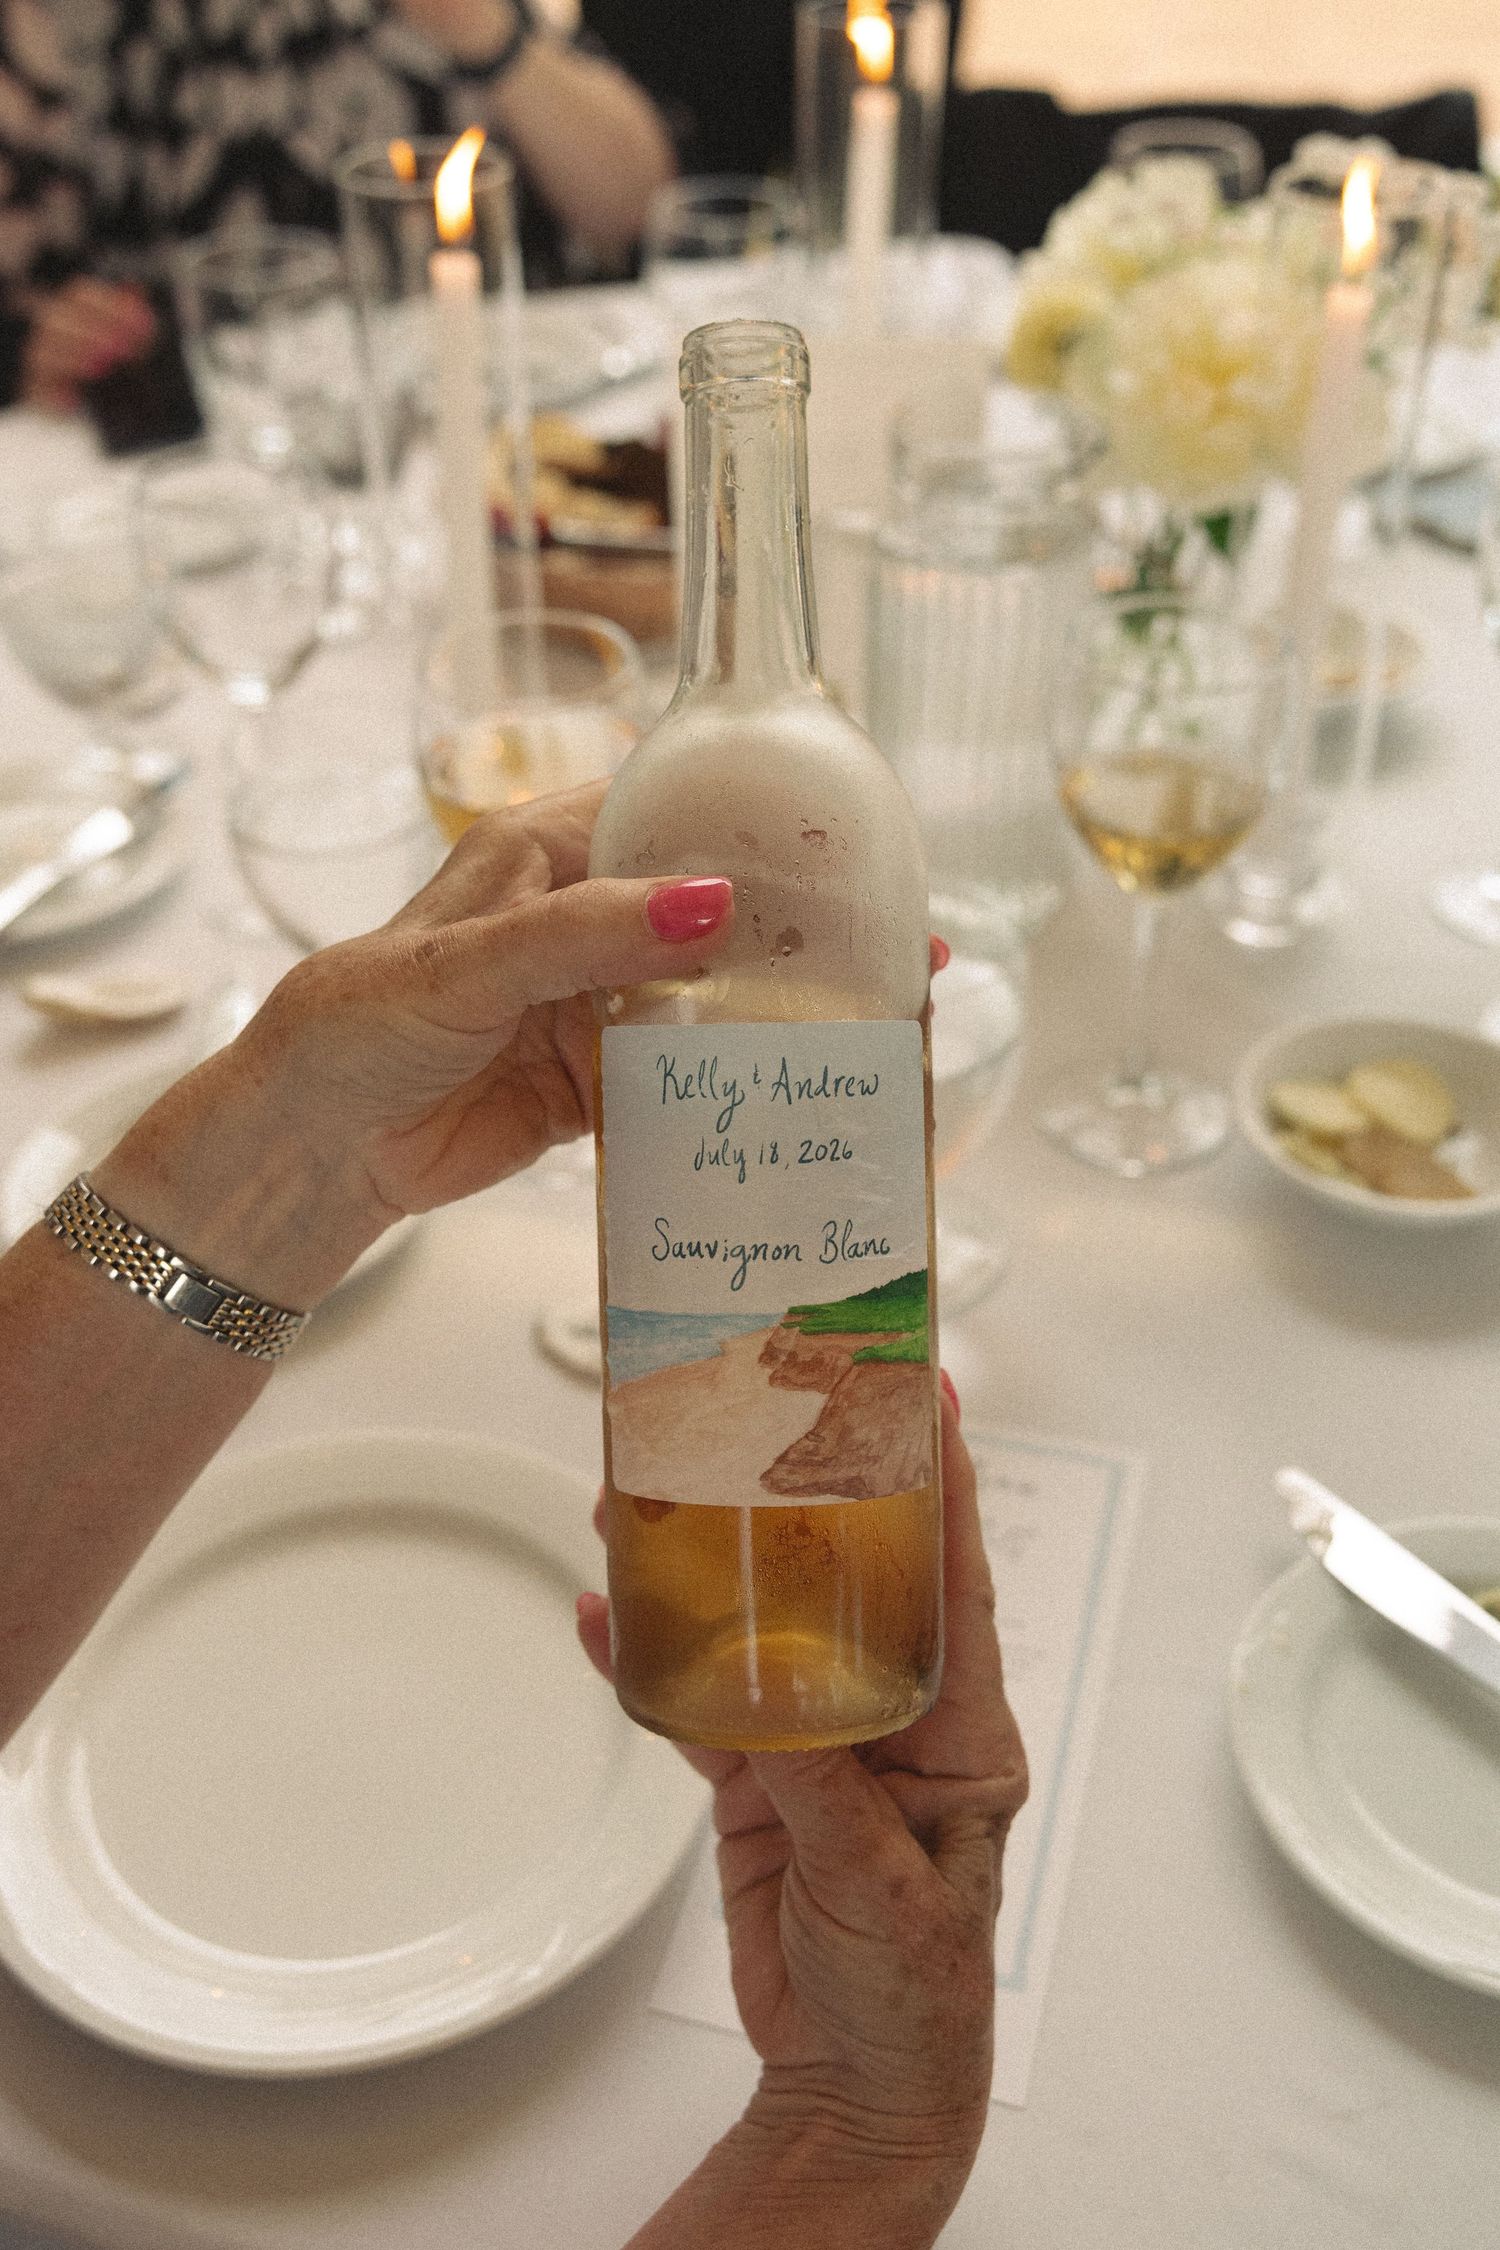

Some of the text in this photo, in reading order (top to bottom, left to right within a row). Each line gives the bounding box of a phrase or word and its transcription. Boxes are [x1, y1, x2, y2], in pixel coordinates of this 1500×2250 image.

[656, 1054, 745, 1133] Kelly
[771, 1057, 879, 1105] Andrew
[694, 1137, 746, 1184] July
[652, 1217, 891, 1291] Sauvignon Blanc
